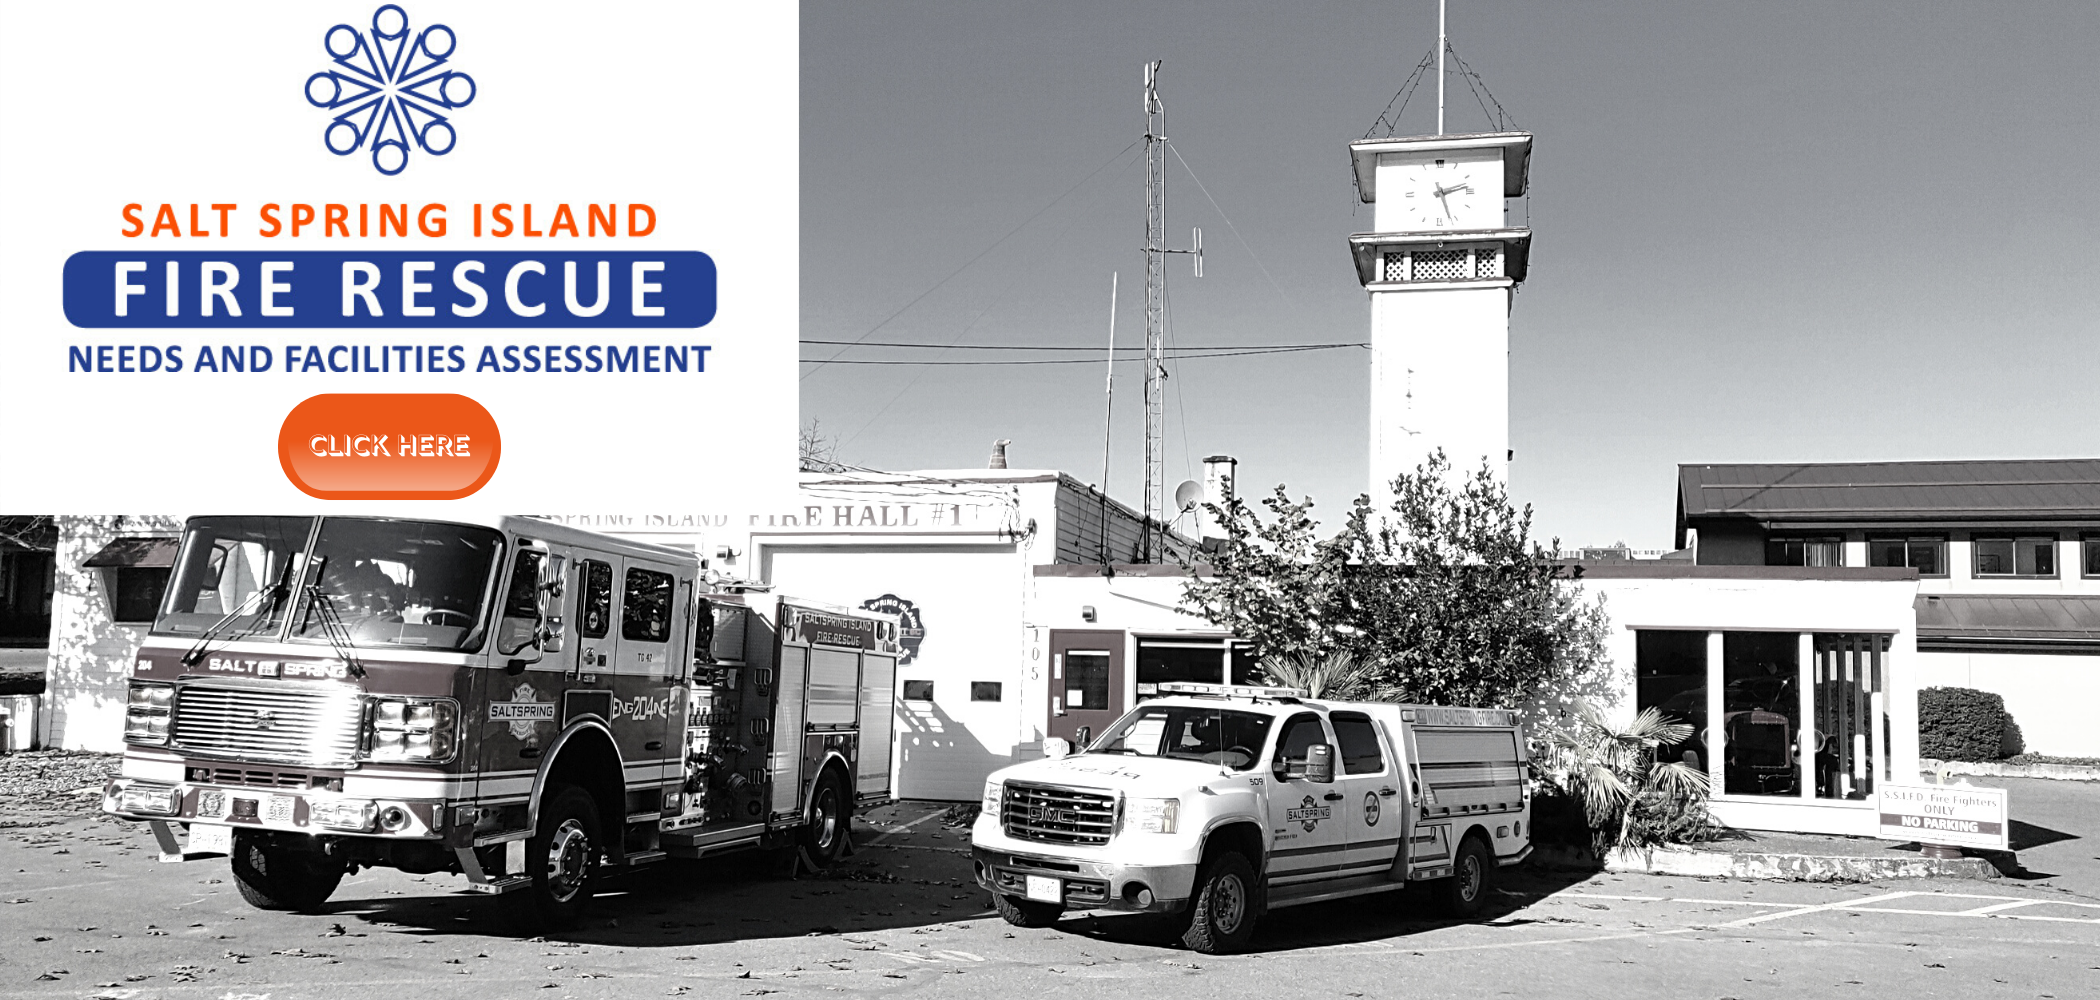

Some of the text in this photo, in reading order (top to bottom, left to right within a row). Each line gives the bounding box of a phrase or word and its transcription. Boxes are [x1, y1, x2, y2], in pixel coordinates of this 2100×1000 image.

[833, 506, 918, 527] HALL
[931, 503, 962, 526] #1
[804, 612, 872, 632] SALTSPRING ISLAND
[209, 658, 347, 678] SALT SPRING
[491, 705, 553, 717] SALTSPRING
[1250, 777, 1264, 786] 509
[1930, 793, 1950, 803] Fire
[1953, 796, 1998, 809] Fighters
[1029, 807, 1076, 824] GMC
[1288, 808, 1330, 820] SALTSPRING
[1924, 804, 1955, 815] ONLY
[1901, 815, 1979, 833] NO PARKING
